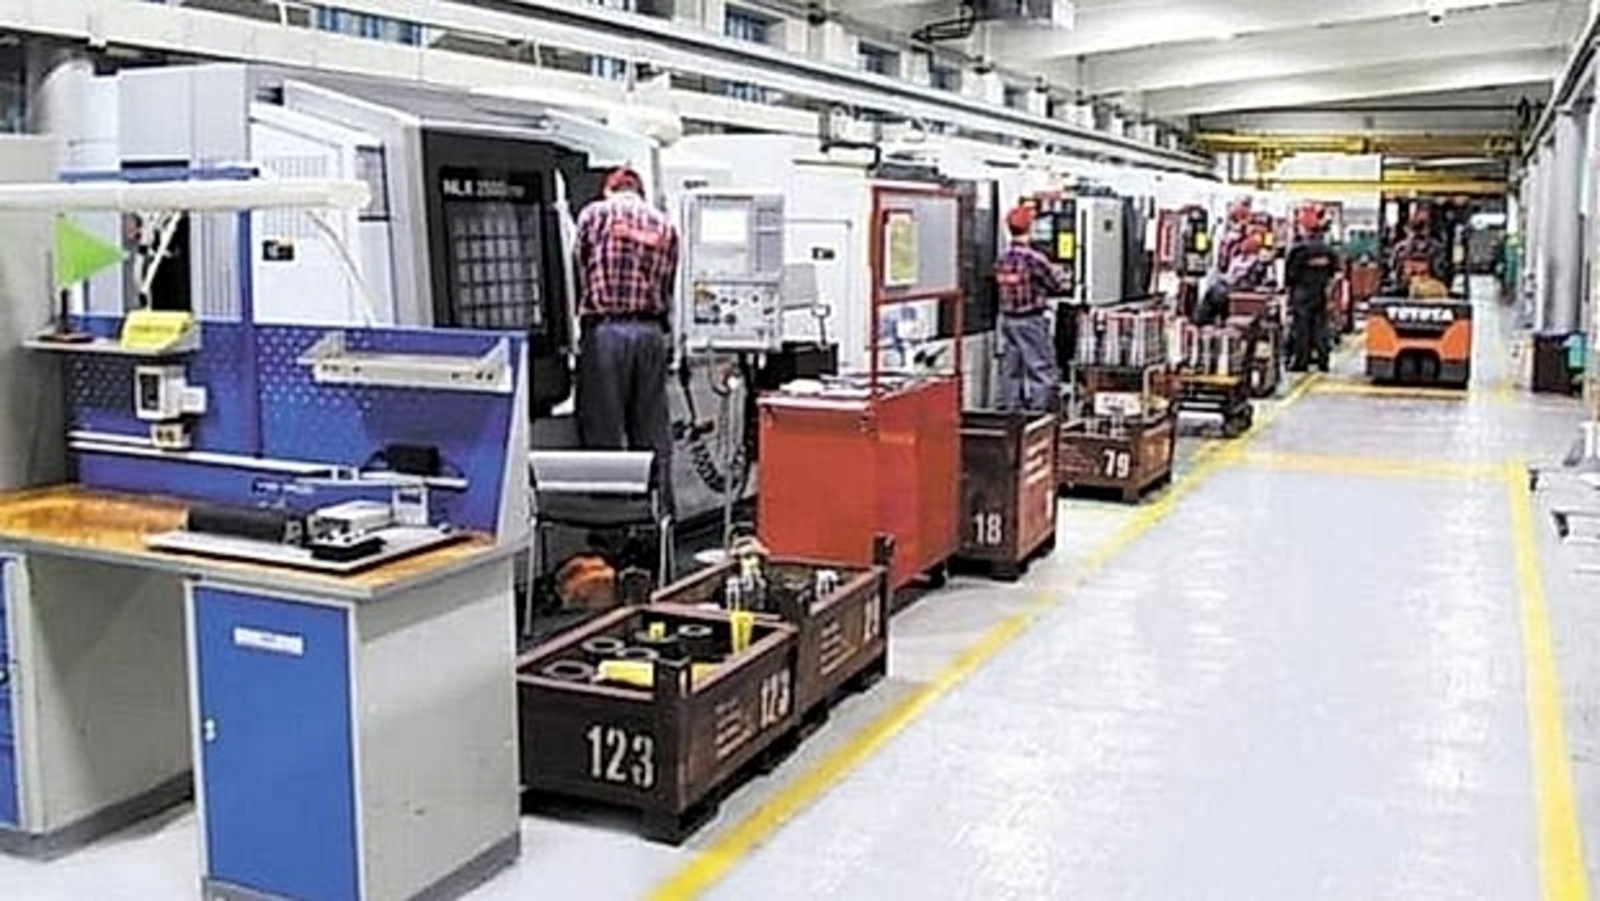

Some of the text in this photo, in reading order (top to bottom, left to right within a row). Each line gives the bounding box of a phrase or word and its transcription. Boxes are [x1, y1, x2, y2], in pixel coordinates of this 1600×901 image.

[1386, 306, 1454, 321] TOYOTA
[1103, 449, 1130, 478] 79
[975, 512, 1002, 545] 18
[587, 725, 655, 788] 123
